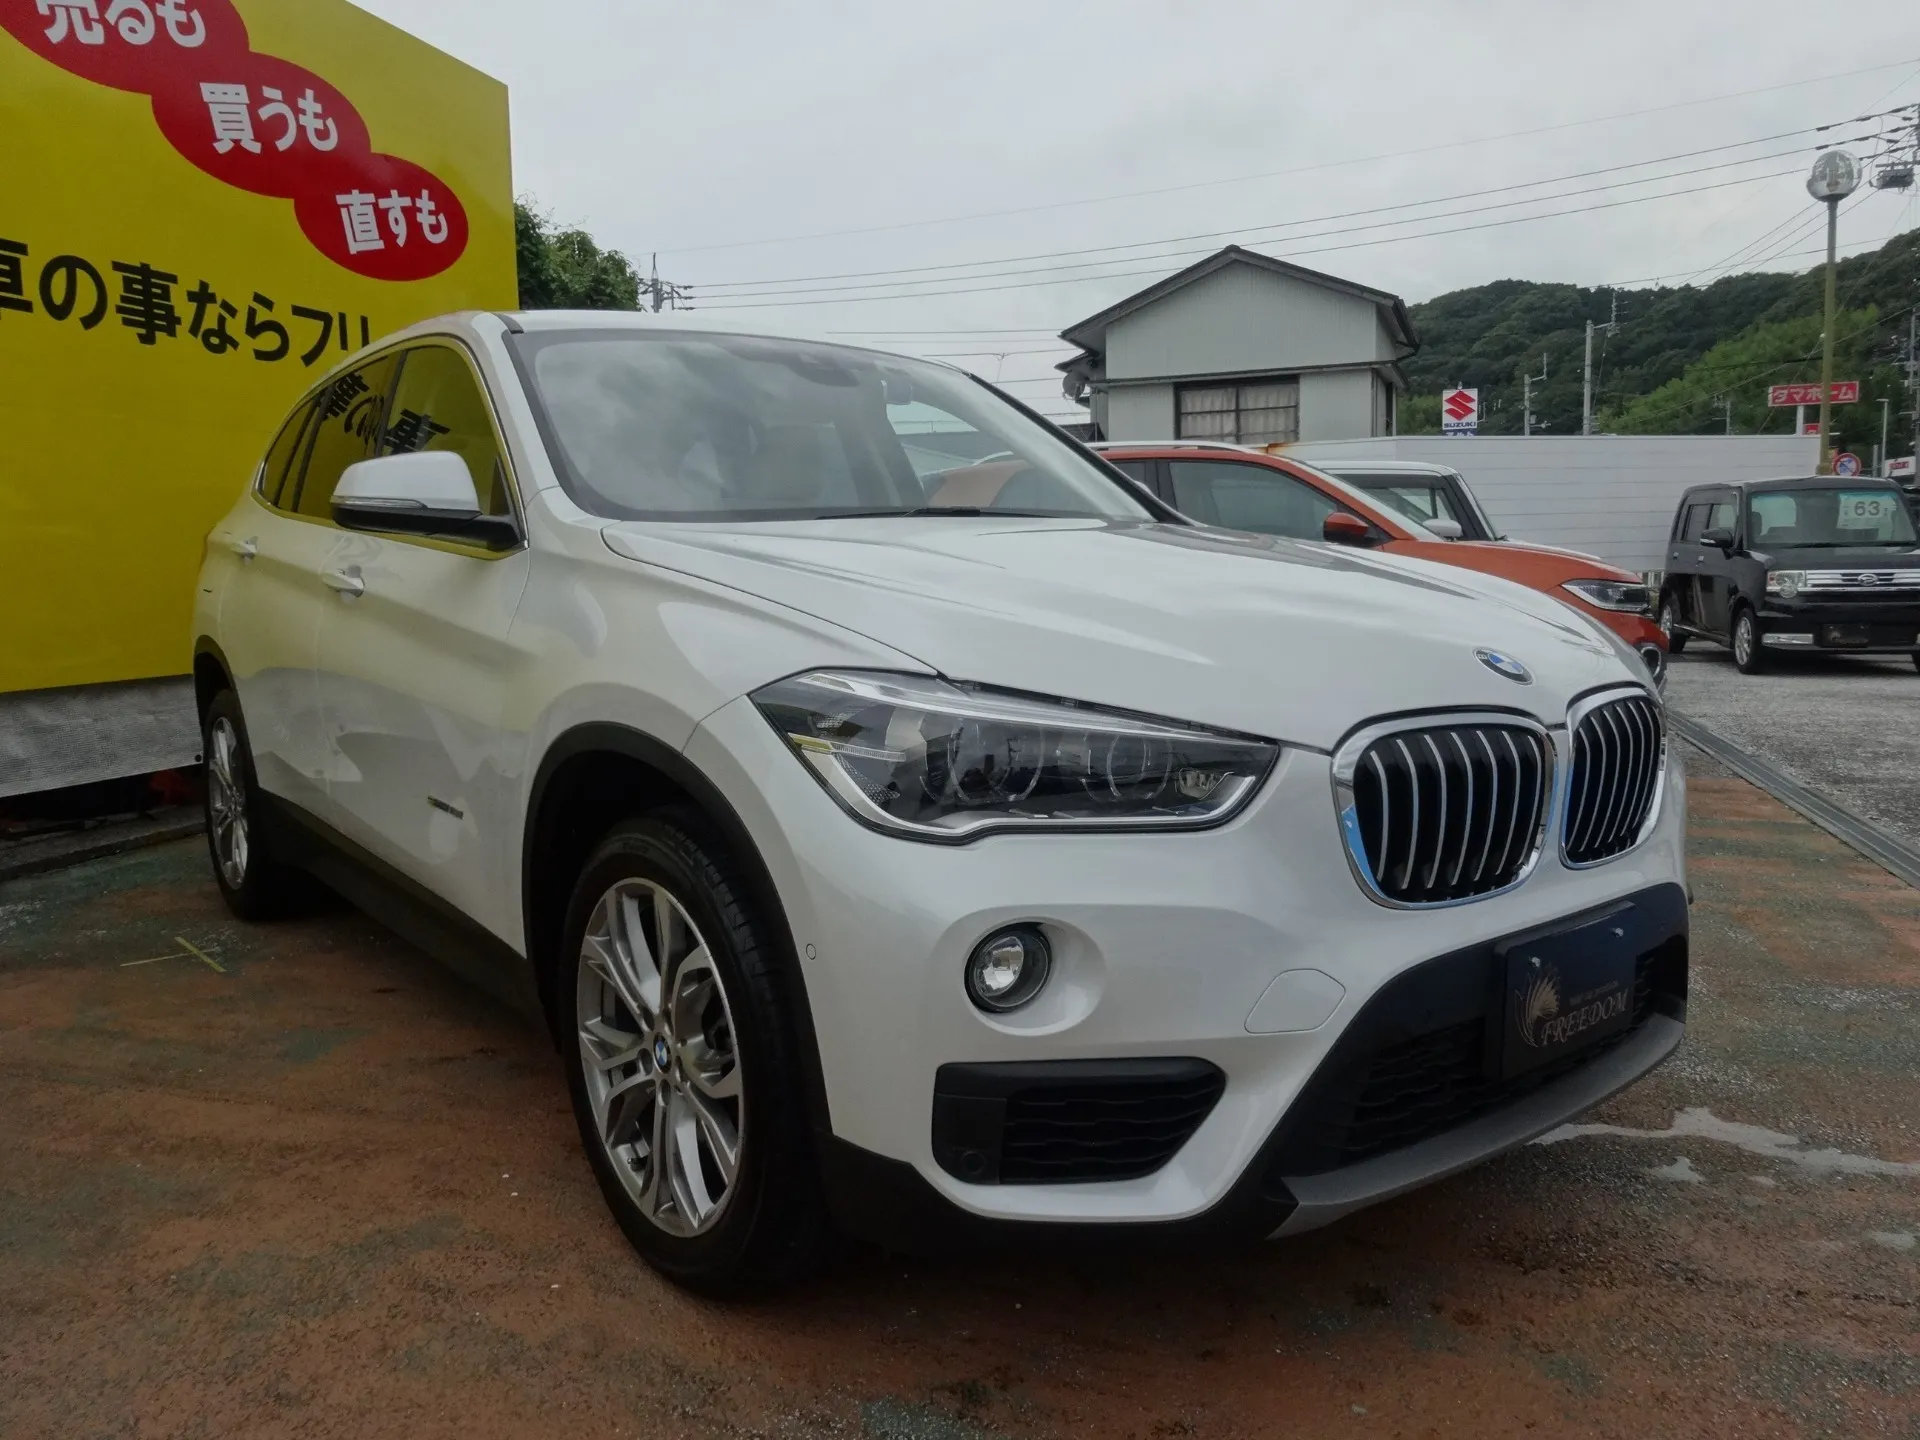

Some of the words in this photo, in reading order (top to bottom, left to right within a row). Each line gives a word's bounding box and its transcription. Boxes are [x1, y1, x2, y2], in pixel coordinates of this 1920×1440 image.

[199, 81, 339, 154] 買うも
[335, 189, 449, 255] 直すも
[1854, 501, 1880, 516] 63
[1541, 989, 1628, 1047] FREEDOM
